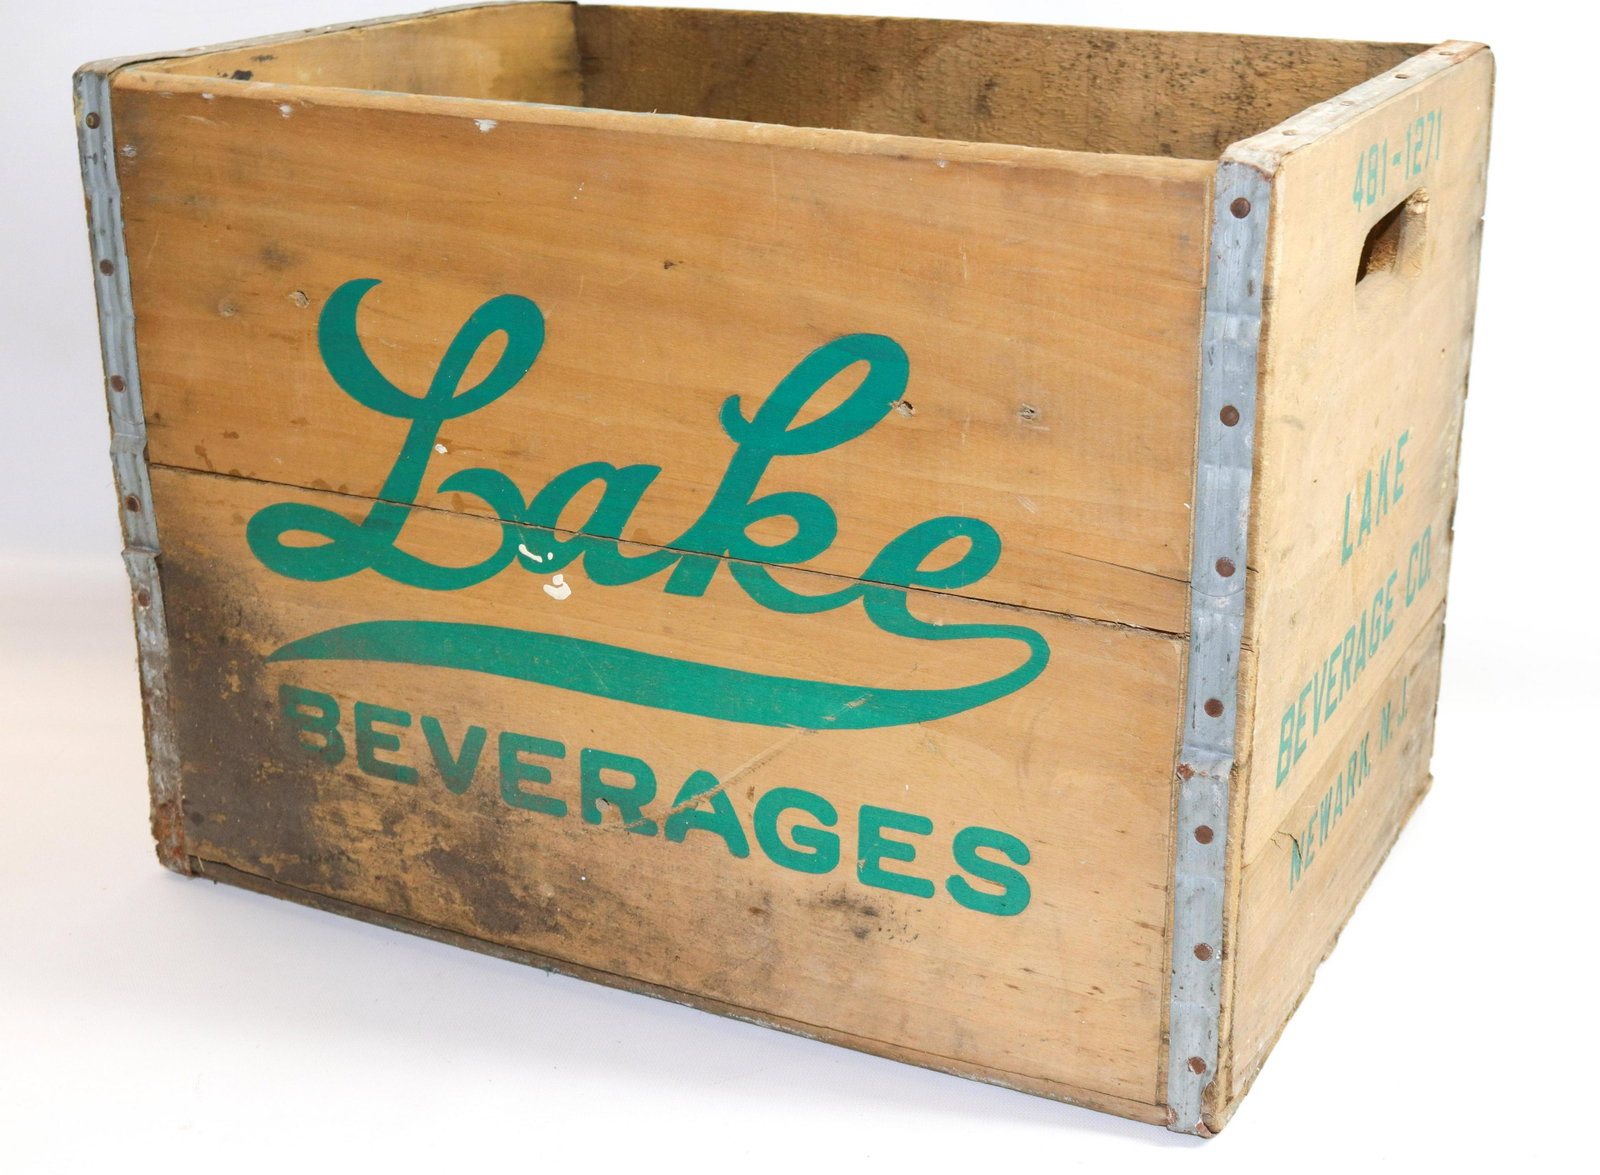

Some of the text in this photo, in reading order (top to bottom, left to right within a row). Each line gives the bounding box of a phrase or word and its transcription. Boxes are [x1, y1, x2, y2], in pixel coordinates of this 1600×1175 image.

[1353, 107, 1442, 212] 481-1271
[247, 279, 1049, 645] Lake
[1341, 429, 1409, 566] LAKE
[1275, 568, 1398, 790] BEVERAGE
[279, 686, 1031, 917] BEVERAGES
